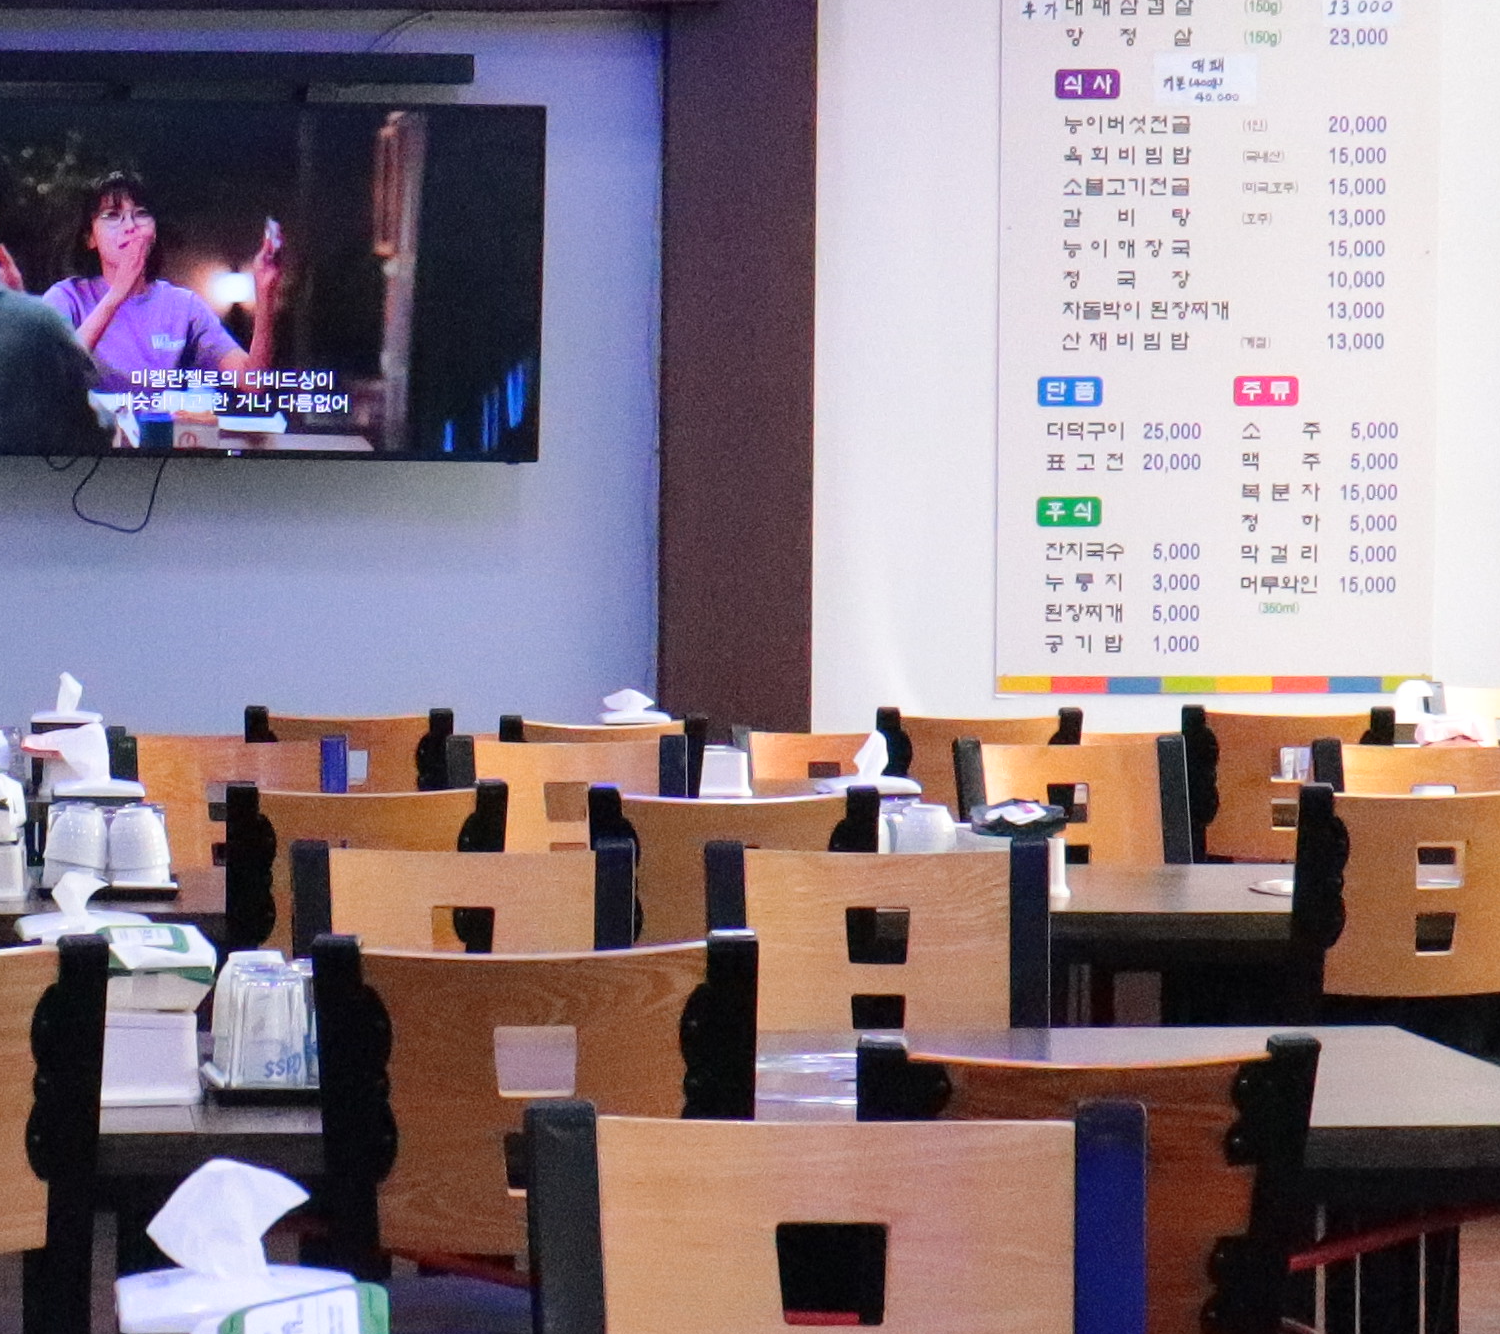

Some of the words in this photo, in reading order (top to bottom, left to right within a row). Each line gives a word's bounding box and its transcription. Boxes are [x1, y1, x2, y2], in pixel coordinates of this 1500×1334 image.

[1245, 0, 1282, 16] (150g)
[1330, 28, 1388, 47] 23,000
[1063, 74, 1113, 95] 식사
[1329, 116, 1387, 135] 20,000
[1330, 147, 1386, 165] 15,000
[1329, 178, 1386, 196] 15,000
[1329, 209, 1385, 227] 13,000
[1328, 240, 1385, 258] 15,000
[1328, 271, 1385, 289] 10,000
[1151, 301, 1229, 320] 된장찌개
[1328, 302, 1384, 320] 13,000
[1328, 332, 1384, 351] 13,000
[132, 369, 237, 389] 미켈란젤로의
[245, 370, 334, 390] 다비드상이
[236, 393, 271, 413] 거나
[278, 393, 349, 413] 다름없어
[1047, 422, 1124, 441] 더덕구이
[1144, 422, 1201, 441] 25,000
[1242, 422, 1321, 440] 소주
[1351, 422, 1398, 440] 5,000
[1047, 453, 1123, 471] 표고전
[1143, 453, 1201, 472] 20,000
[1242, 452, 1320, 471] 맥주
[1351, 453, 1398, 472] 5,000
[1341, 484, 1398, 502] 15,000
[1046, 502, 1093, 522] 후식
[1350, 515, 1397, 533] 5,000
[1153, 543, 1200, 561] 5,000
[1241, 545, 1317, 564] 막걸리
[1350, 545, 1396, 564] 5,000
[1153, 573, 1200, 592] 3,000
[1241, 576, 1317, 594] 머루와인
[1340, 576, 1396, 594] 15,000
[1046, 604, 1122, 622] 된장찌개
[1153, 604, 1200, 623] 5,000
[1045, 635, 1123, 653] 공기밥
[1154, 635, 1199, 654] 1,000
